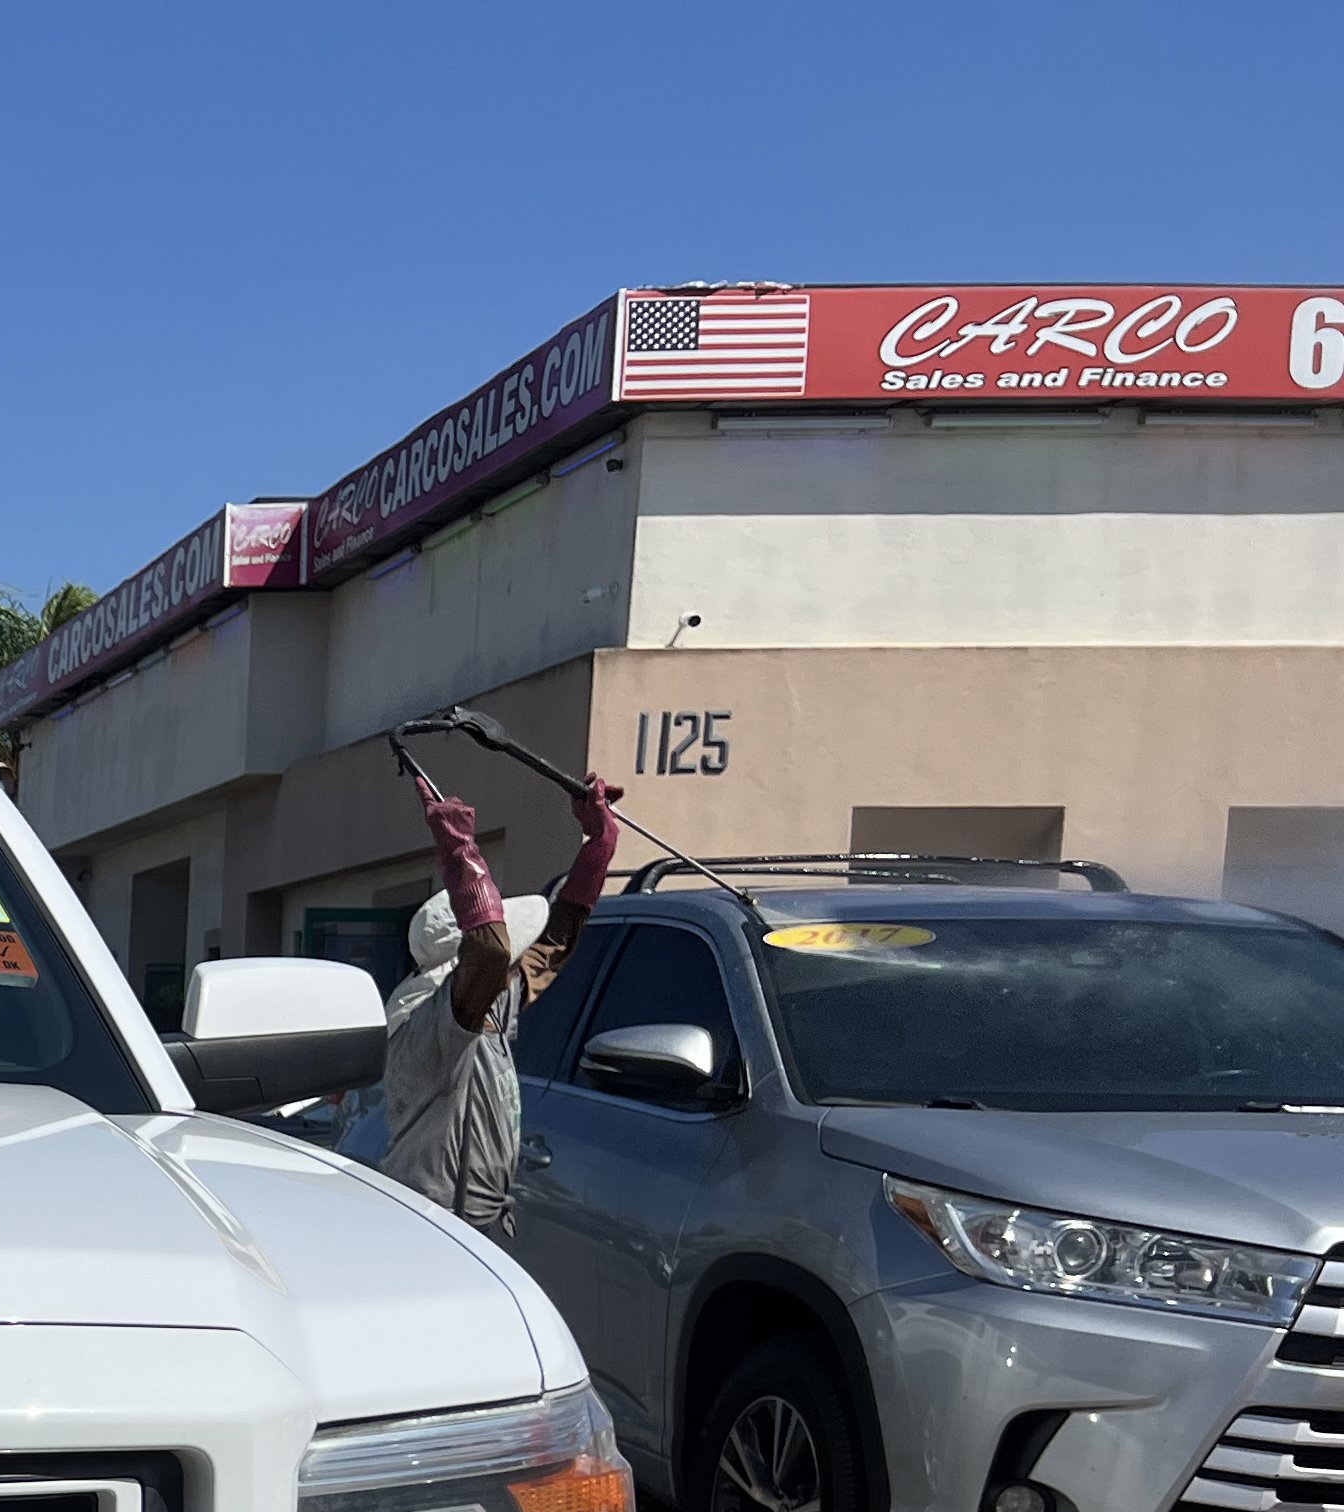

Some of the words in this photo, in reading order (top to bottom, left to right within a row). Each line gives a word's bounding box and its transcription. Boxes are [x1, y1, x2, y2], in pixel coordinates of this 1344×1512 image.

[879, 294, 1238, 367] CARCO
[880, 368, 985, 391] Sales
[996, 368, 1069, 389] and
[1077, 366, 1228, 389] Finance
[379, 311, 610, 519] CARCOSALES.COM
[47, 519, 221, 685] CARCOSALES.COM
[635, 710, 732, 776] 1125
[2, 960, 21, 970] OK
